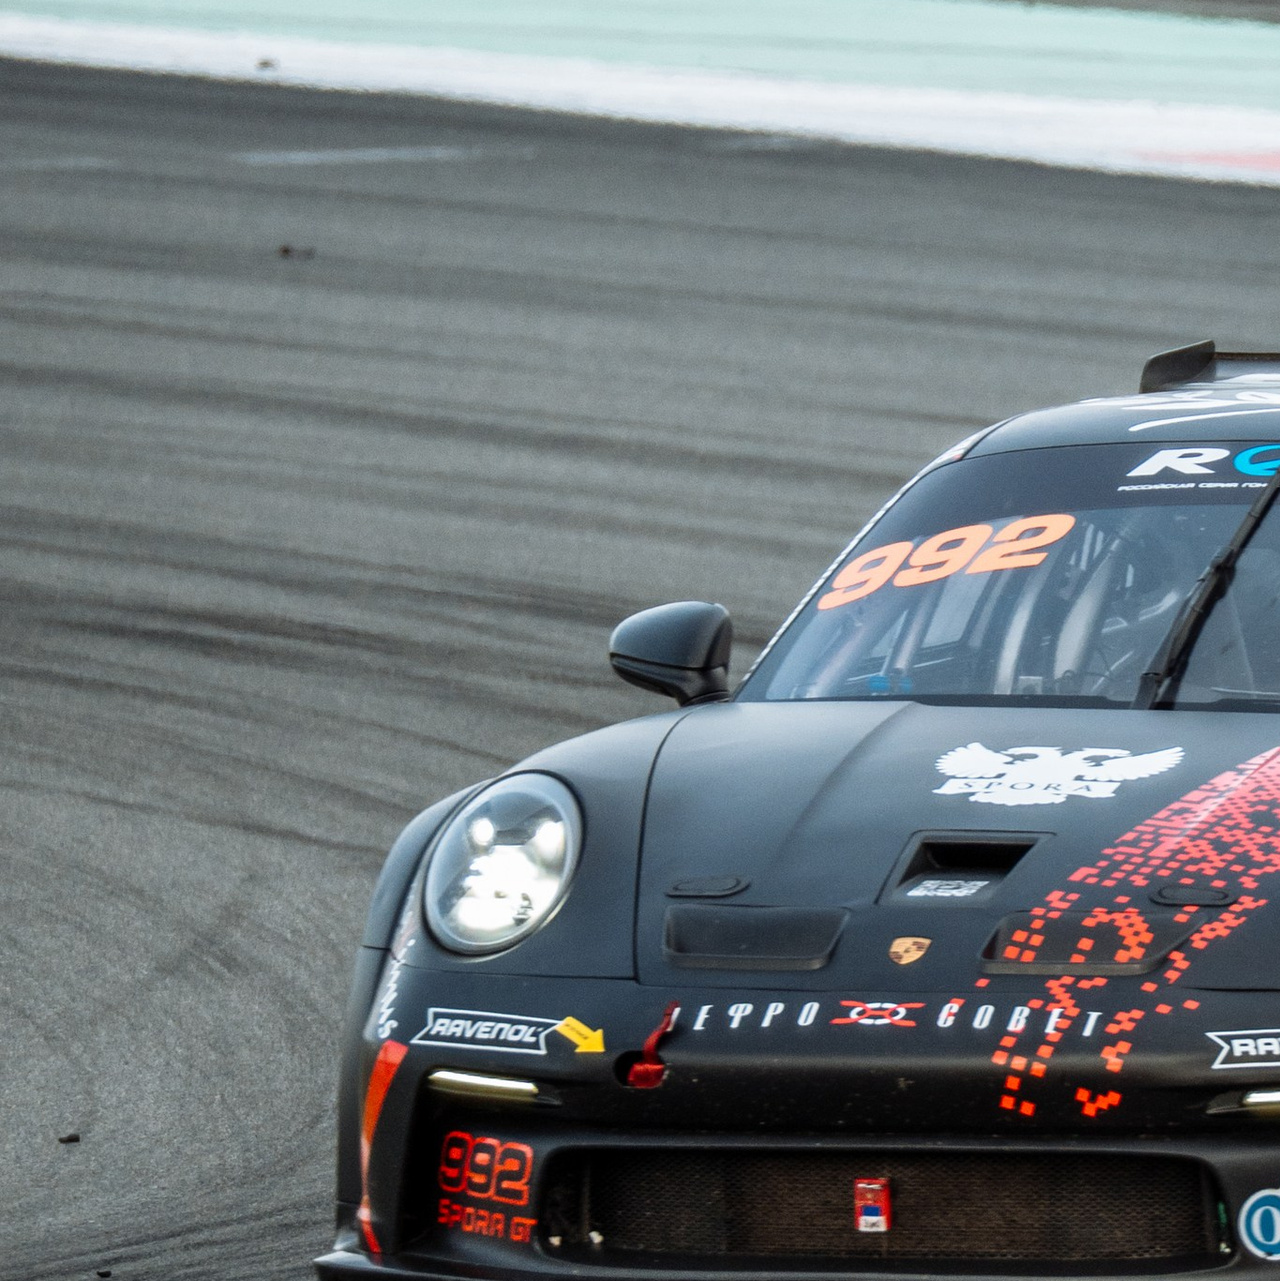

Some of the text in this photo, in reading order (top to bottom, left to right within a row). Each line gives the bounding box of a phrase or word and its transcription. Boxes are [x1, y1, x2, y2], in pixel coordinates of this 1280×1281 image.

[816, 512, 1077, 611] 992
[957, 781, 1094, 793] SPORA
[429, 1017, 541, 1043] RAVENOL
[936, 1002, 1104, 1037] СОВЕТ
[438, 1130, 534, 1207] 992
[437, 1198, 538, 1243] SPORA GT
